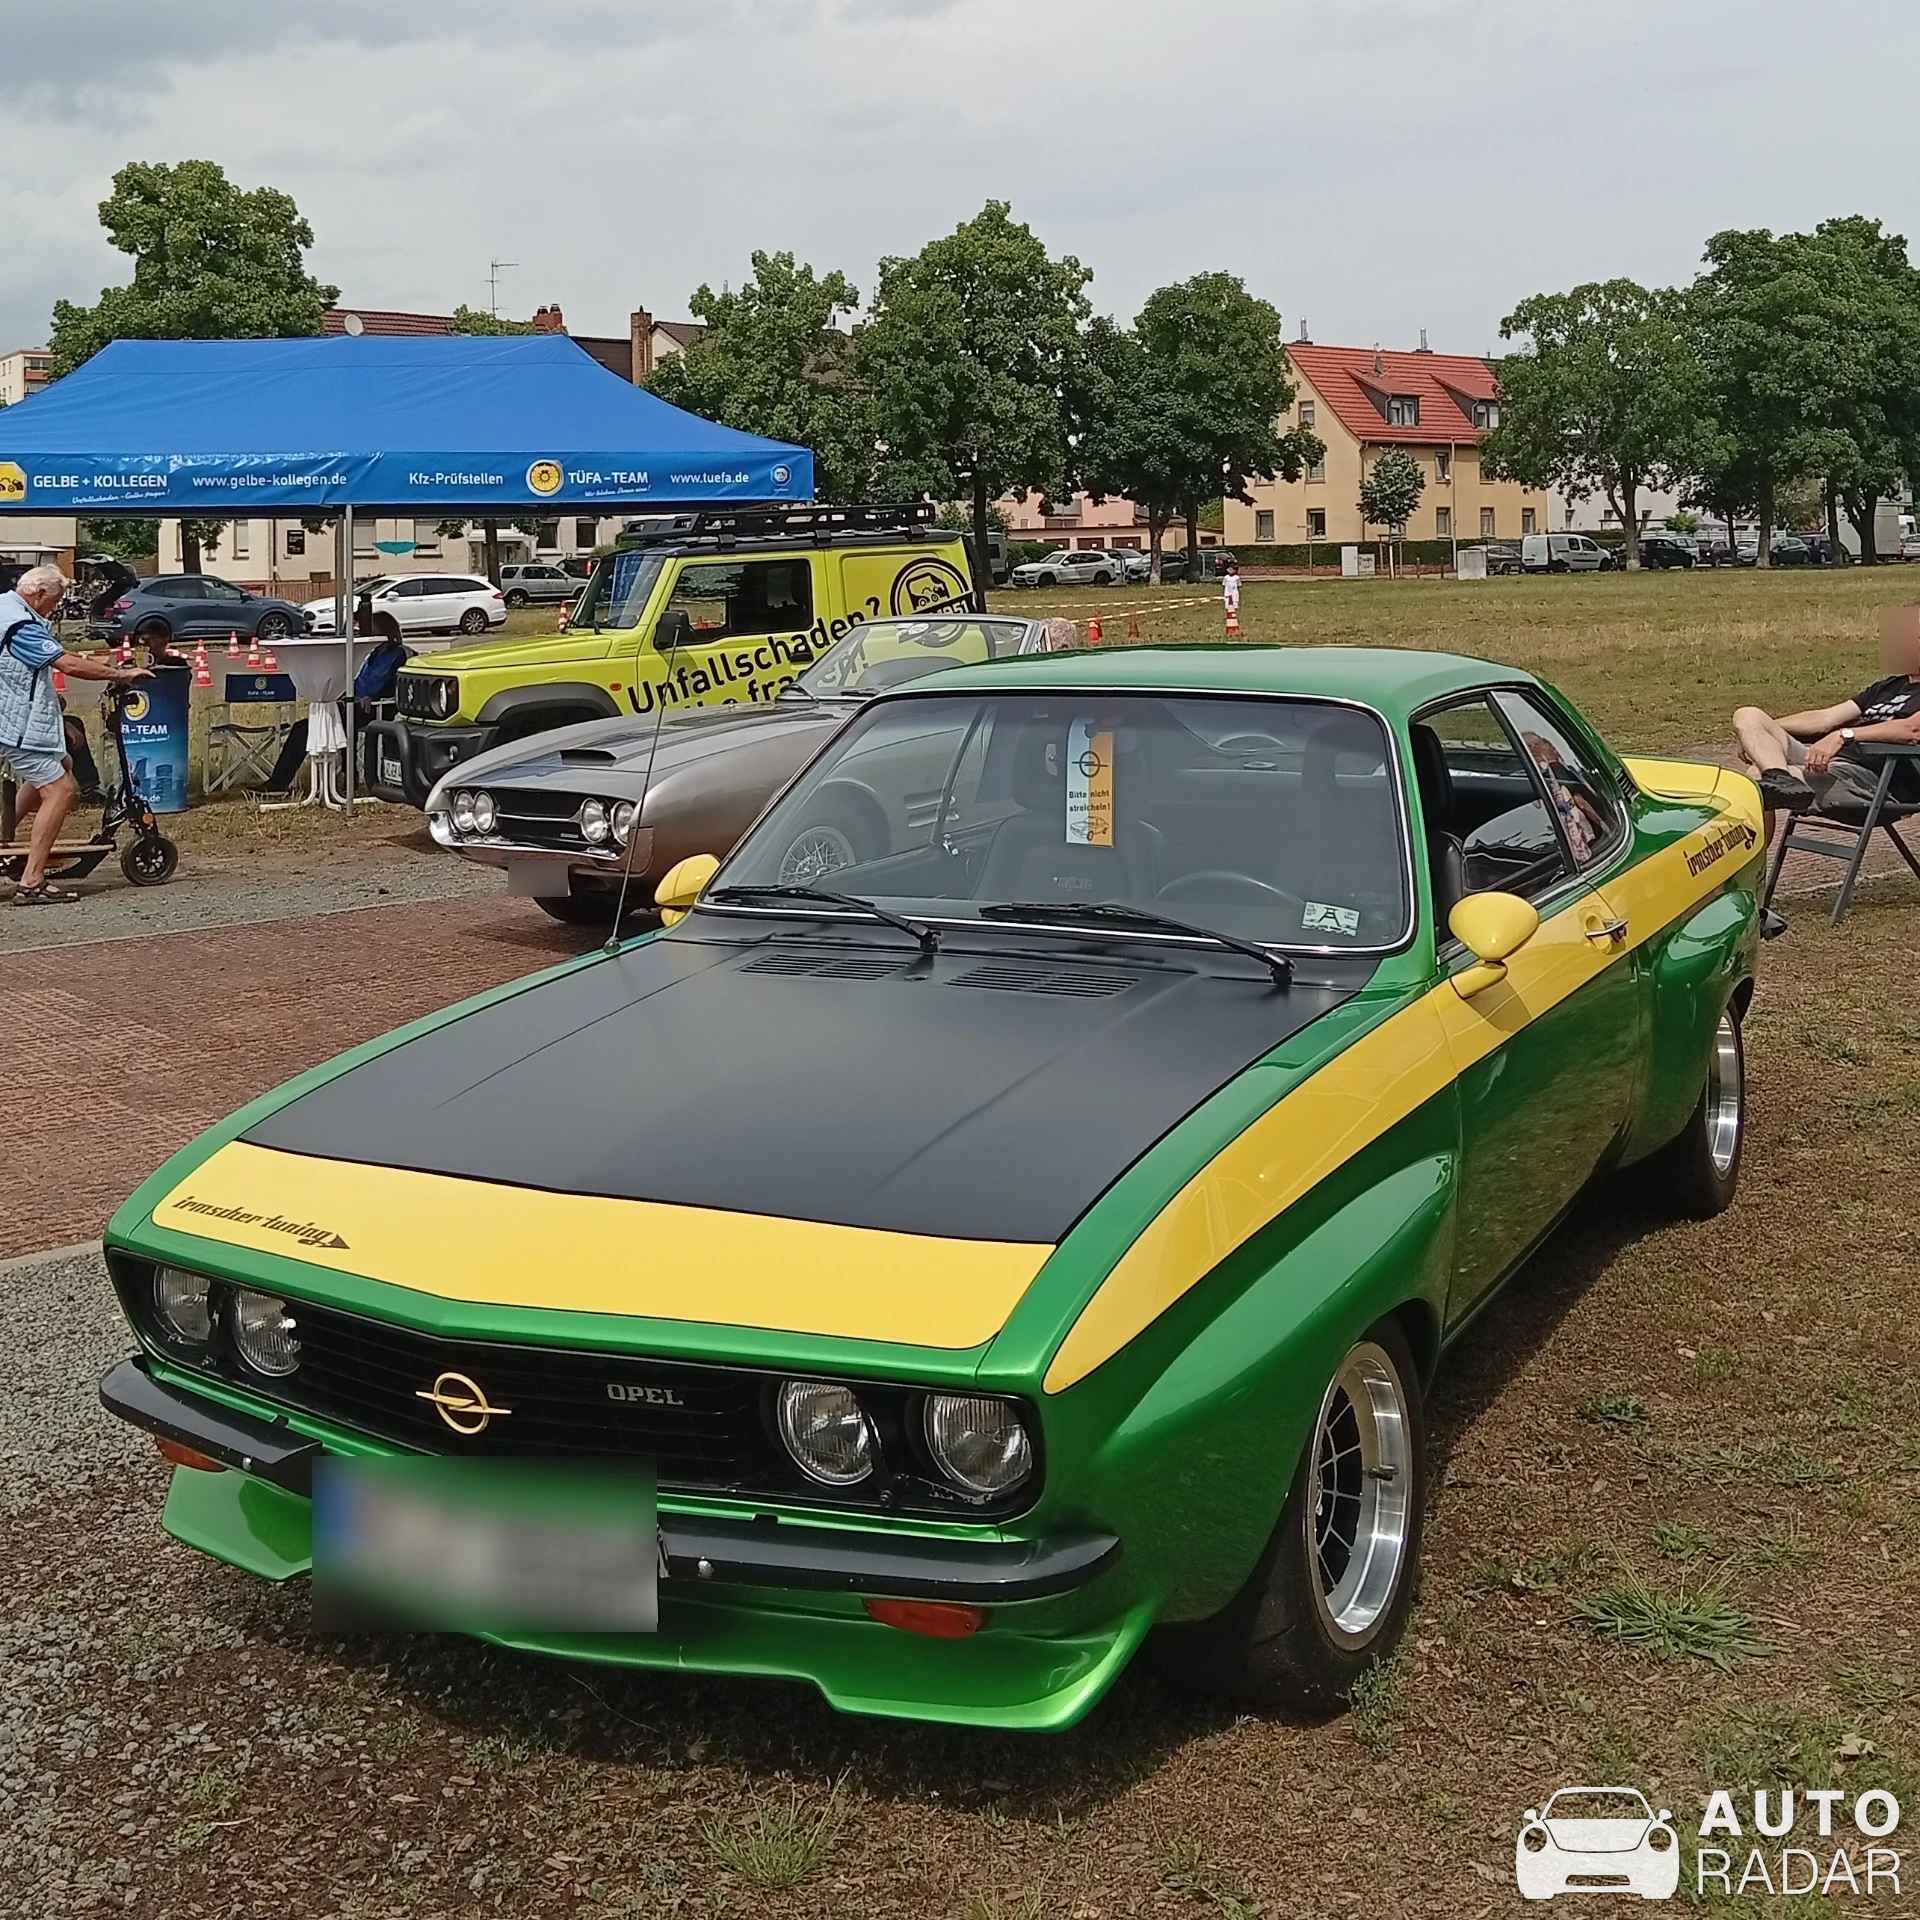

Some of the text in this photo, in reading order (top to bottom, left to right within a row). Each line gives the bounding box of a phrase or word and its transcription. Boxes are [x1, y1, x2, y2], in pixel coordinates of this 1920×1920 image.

[33, 474, 168, 488] GELBE + KOLLEGEN
[192, 473, 347, 489] www.gelbe-kollegen.de
[409, 472, 503, 485] Kfz-Prüfstellen
[670, 471, 749, 484] www.tuefa.de
[1069, 789, 1110, 799] Bitte nicht
[1069, 803, 1111, 813] streicheln!
[260, 1214, 334, 1247] tuning
[606, 1383, 684, 1406] OPEL
